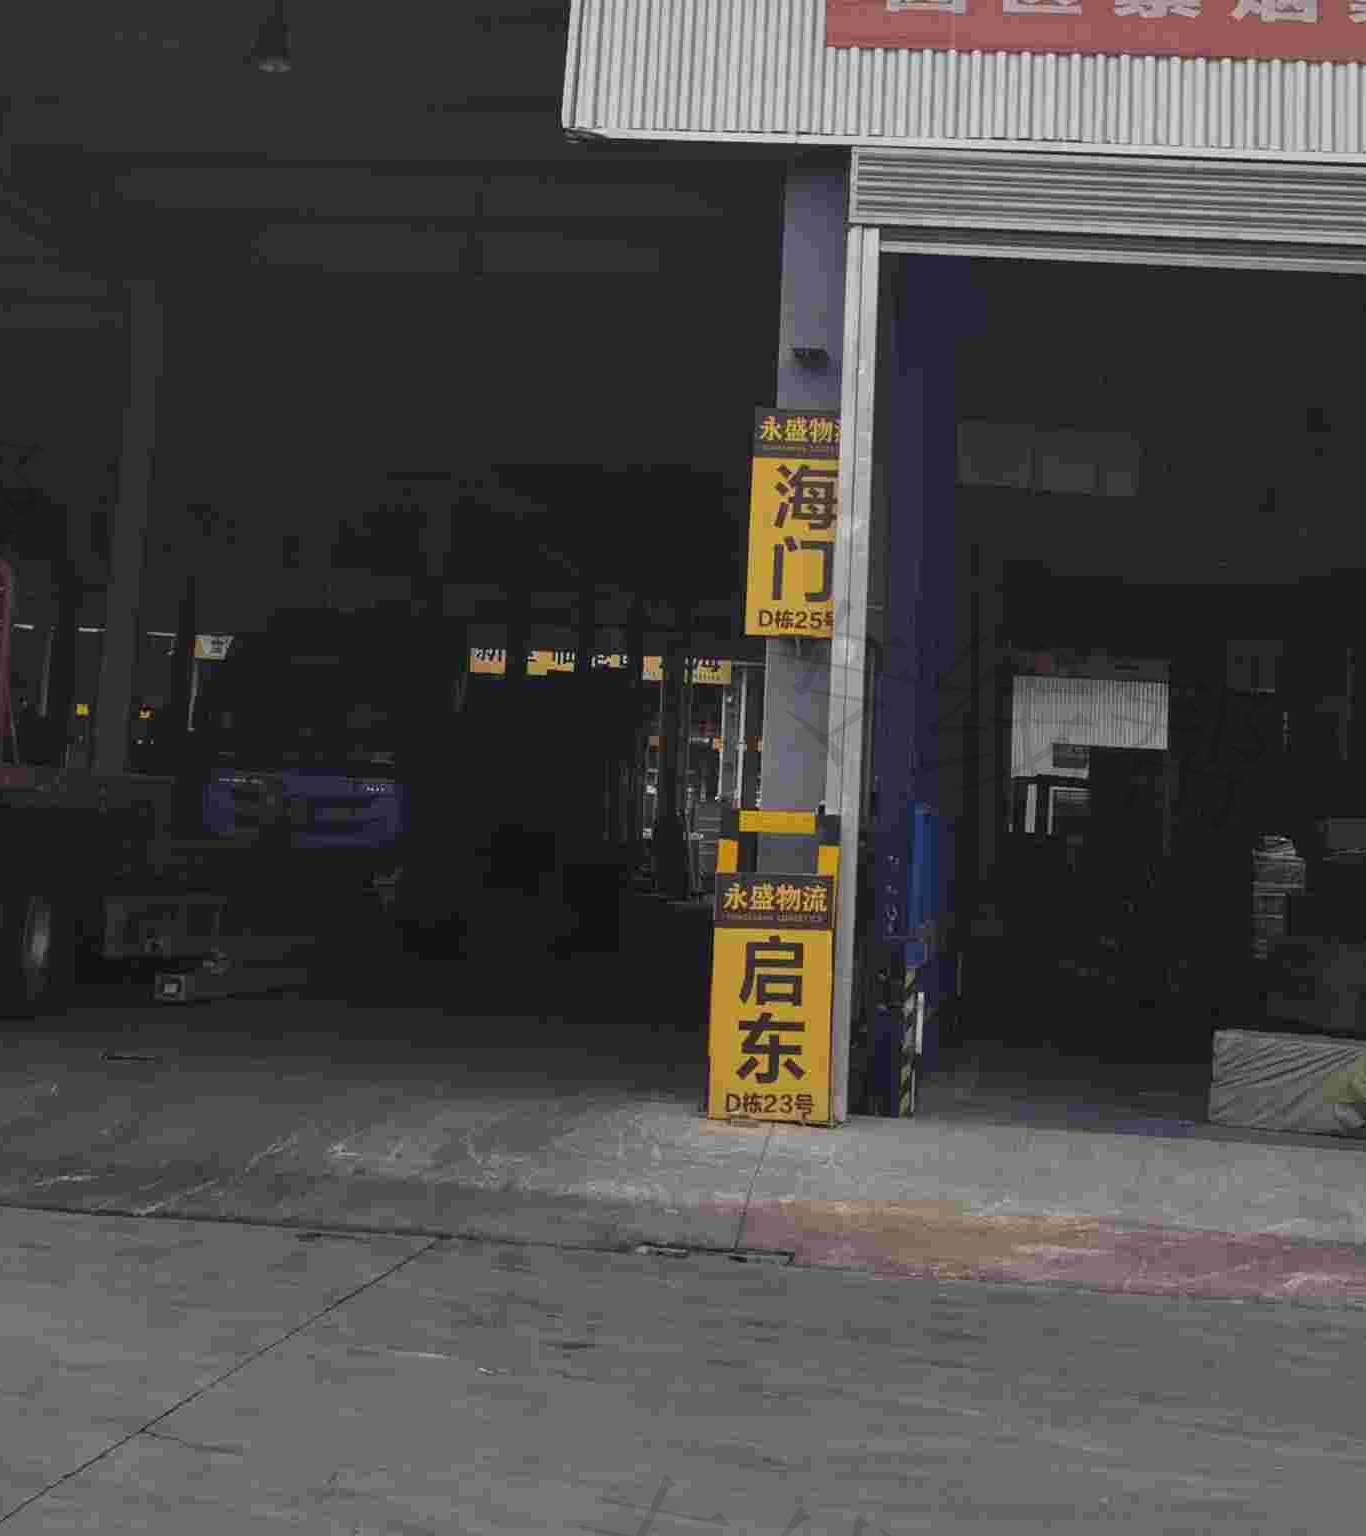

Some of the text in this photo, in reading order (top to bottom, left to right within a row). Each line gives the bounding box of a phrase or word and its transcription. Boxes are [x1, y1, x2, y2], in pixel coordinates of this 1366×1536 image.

[761, 415, 842, 443] 永盛物
[771, 462, 838, 603] 海门
[722, 883, 828, 914] 永盛物流
[737, 933, 806, 1085] 启东
[724, 1091, 816, 1117] D栋23号
